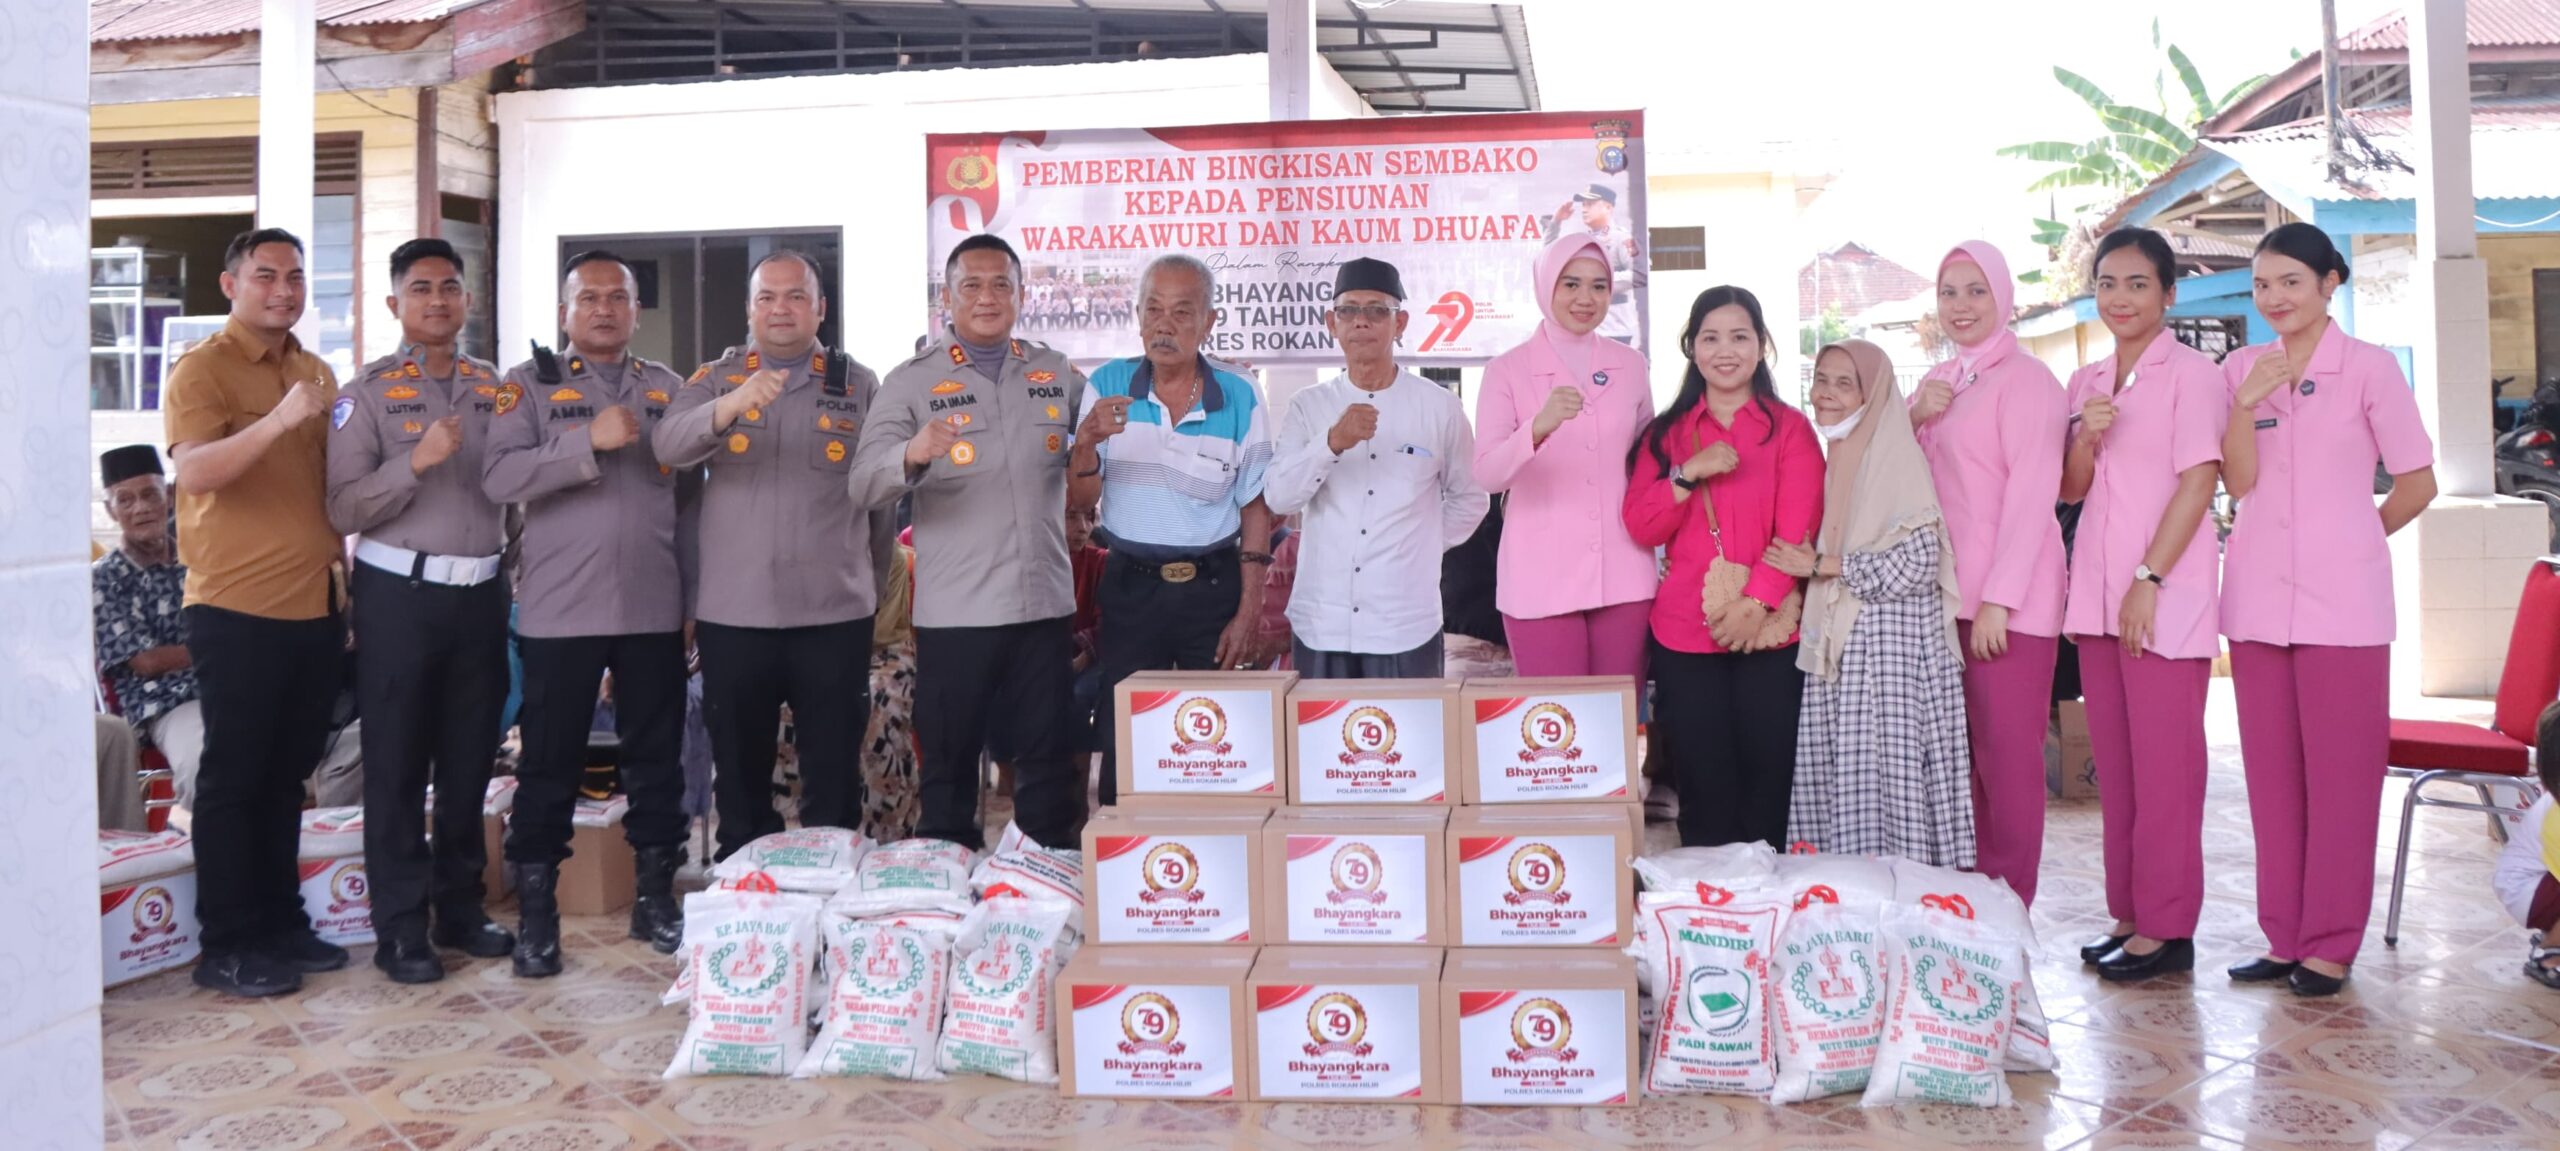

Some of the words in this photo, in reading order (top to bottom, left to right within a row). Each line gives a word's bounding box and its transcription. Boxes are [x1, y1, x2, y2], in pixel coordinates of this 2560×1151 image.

[1022, 157, 1196, 186] PEMBERIAN
[1207, 151, 1374, 181] BINGKISAN
[1384, 147, 1538, 176] SEMBAKO
[1125, 188, 1246, 216] KEPADA
[1257, 183, 1430, 213] PENSIUNAN
[1021, 220, 1228, 251] WARAKAWURI
[1238, 219, 1300, 248] DAN
[1311, 217, 1401, 245] KAUM
[1412, 214, 1542, 242] DHUAFA
[1205, 251, 1267, 273] Dalam
[1235, 305, 1325, 327] TAHUN
[1201, 332, 1245, 350] RES
[1252, 330, 1334, 350] ROKAN
[929, 399, 947, 412] ISA
[949, 394, 977, 408] IMAM
[1028, 386, 1064, 398] POLRI
[386, 403, 427, 414] LUTHFI
[551, 406, 594, 420] AMRI
[816, 399, 857, 413] POLRI
[1189, 712, 1213, 736] 79
[1358, 722, 1382, 746] 79
[1537, 718, 1561, 742] 79
[1158, 758, 1247, 771] Bhayangkara
[1326, 768, 1416, 780] Bhayangkara
[1505, 764, 1598, 778] Bhayangkara
[1159, 858, 1184, 884] 79
[1345, 859, 1368, 884] 79
[1524, 860, 1550, 885] 79
[1126, 907, 1220, 920] Bhayangkara
[1314, 908, 1401, 920] Bhayangkara
[1490, 909, 1587, 922] Bhayangkara
[1678, 928, 1754, 951] MANDIRI
[1806, 932, 1834, 952] JAYA
[1835, 930, 1873, 944] BARU
[1930, 937, 1959, 959] JAYA
[1962, 948, 2002, 971] BARU
[1138, 1008, 1164, 1034] 79
[1324, 1010, 1350, 1036] 79
[1528, 1014, 1556, 1042] 79
[1808, 1028, 1840, 1040] BERAS
[1840, 1026, 1870, 1038] PULEN
[1915, 1021, 1948, 1036] BERAS
[1950, 1028, 1984, 1044] PULEN
[1678, 1038, 1706, 1050] PADI
[1708, 1042, 1752, 1052] SAWAH
[1818, 1042, 1842, 1052] MUTU
[1922, 1034, 1946, 1046] MUTU
[1948, 1040, 1990, 1058] TERJAMIN
[1104, 1058, 1202, 1072] Bhayangkara
[1288, 1060, 1390, 1074] Bhayangkara
[1492, 1066, 1594, 1080] Bhayangkara
